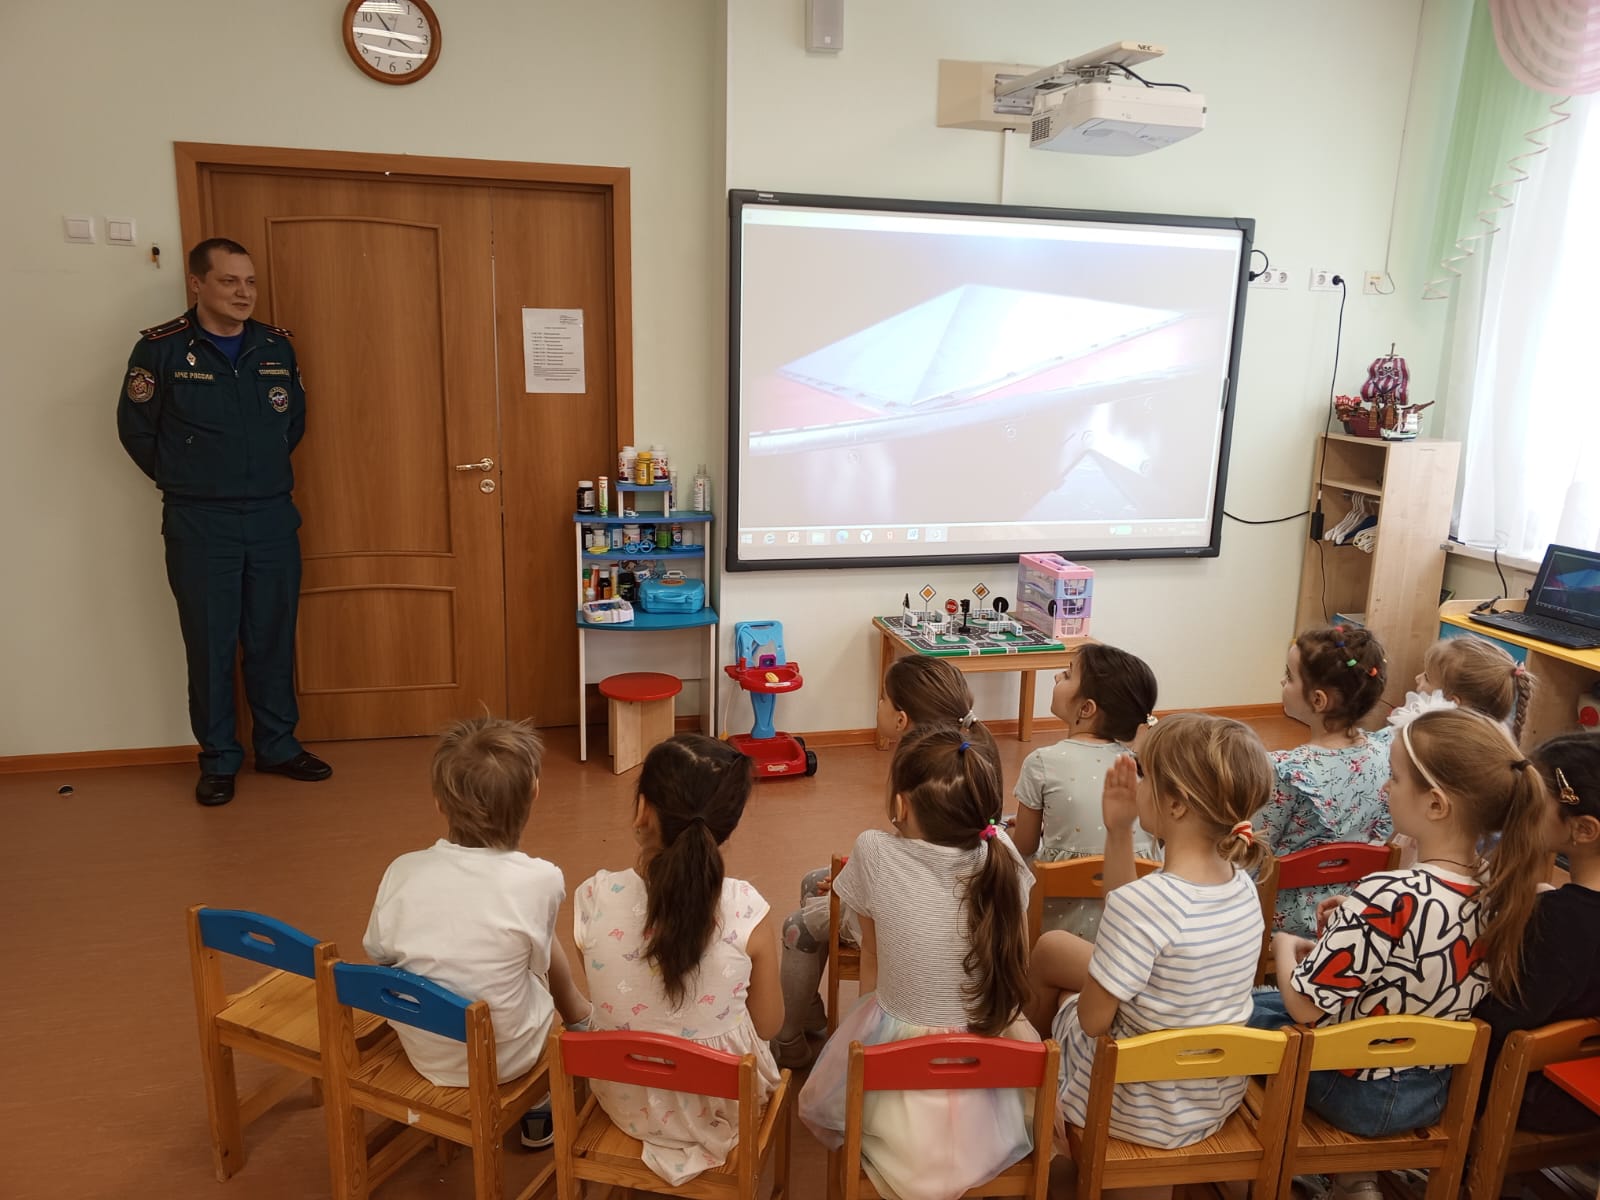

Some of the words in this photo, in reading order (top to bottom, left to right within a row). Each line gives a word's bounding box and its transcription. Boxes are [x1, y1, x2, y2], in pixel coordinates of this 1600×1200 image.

[361, 12, 372, 23] 10
[417, 17, 424, 29] 2
[422, 34, 429, 46] 3
[374, 56, 382, 67] 7
[389, 61, 397, 73] 6
[405, 60, 412, 71] 5
[190, 372, 213, 380] РОССИИ
